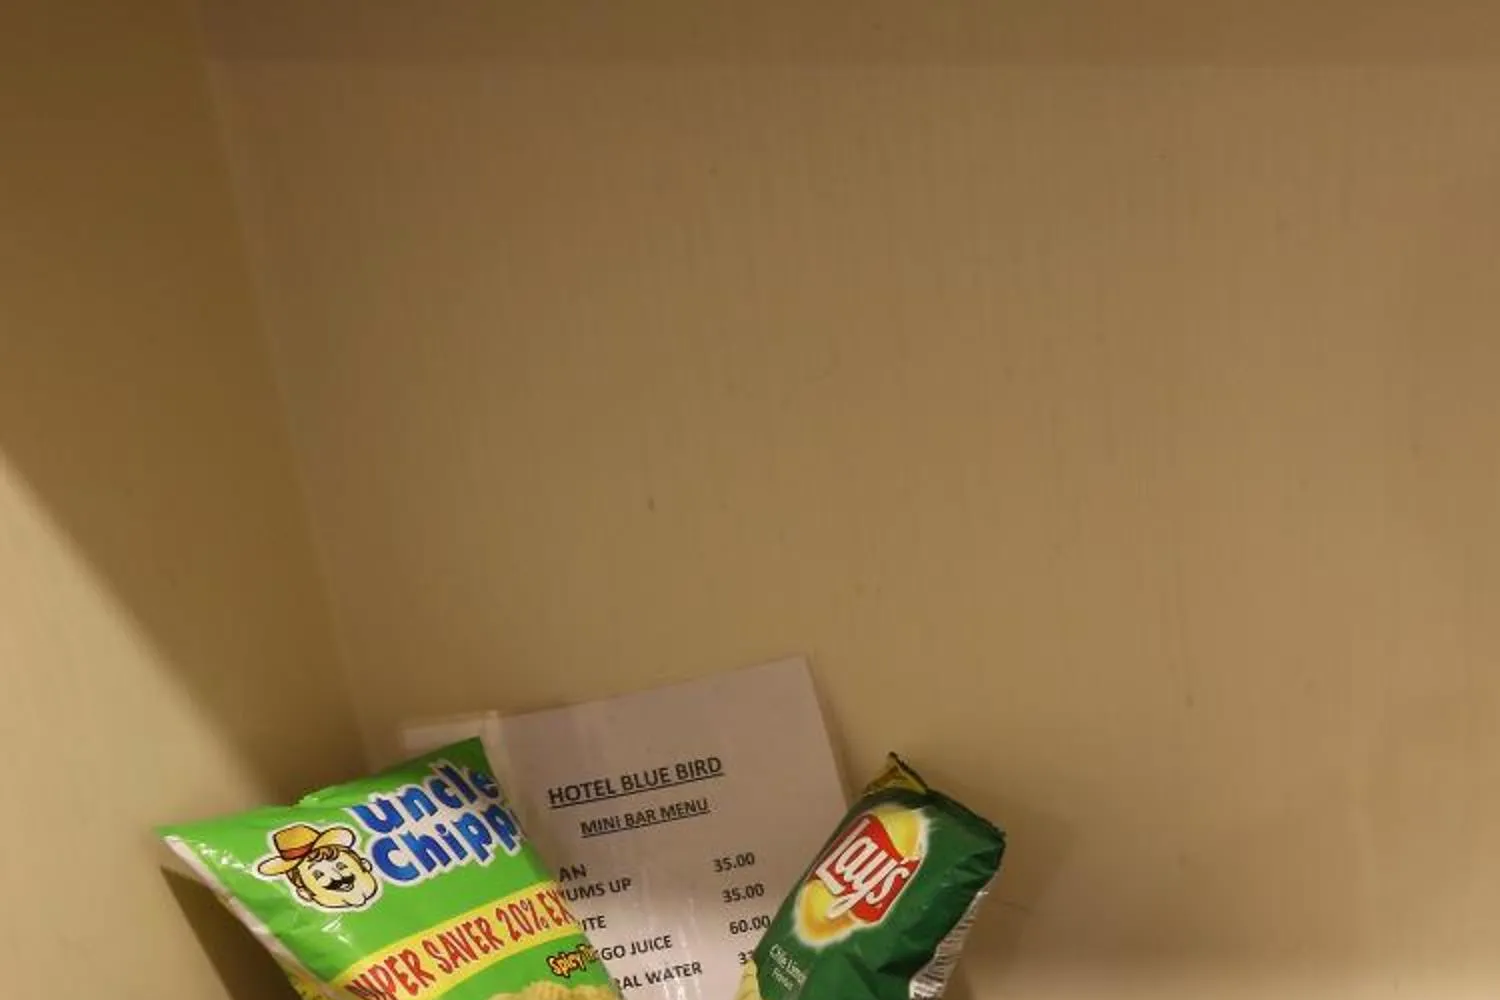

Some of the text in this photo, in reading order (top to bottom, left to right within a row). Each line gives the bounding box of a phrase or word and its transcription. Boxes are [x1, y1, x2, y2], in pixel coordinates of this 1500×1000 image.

[548, 757, 723, 805] HOTEL BLUE BIRD
[580, 798, 710, 835] MINI BAR MENU
[713, 852, 756, 873] 35.00
[609, 877, 632, 893] UP
[722, 883, 765, 903] 35.00
[421, 916, 505, 974] SAVER
[495, 898, 548, 942] 20%
[578, 914, 771, 935] ITE 60.00
[594, 944, 627, 960] GO
[629, 935, 673, 956] JUICE
[644, 962, 703, 986] WATER
